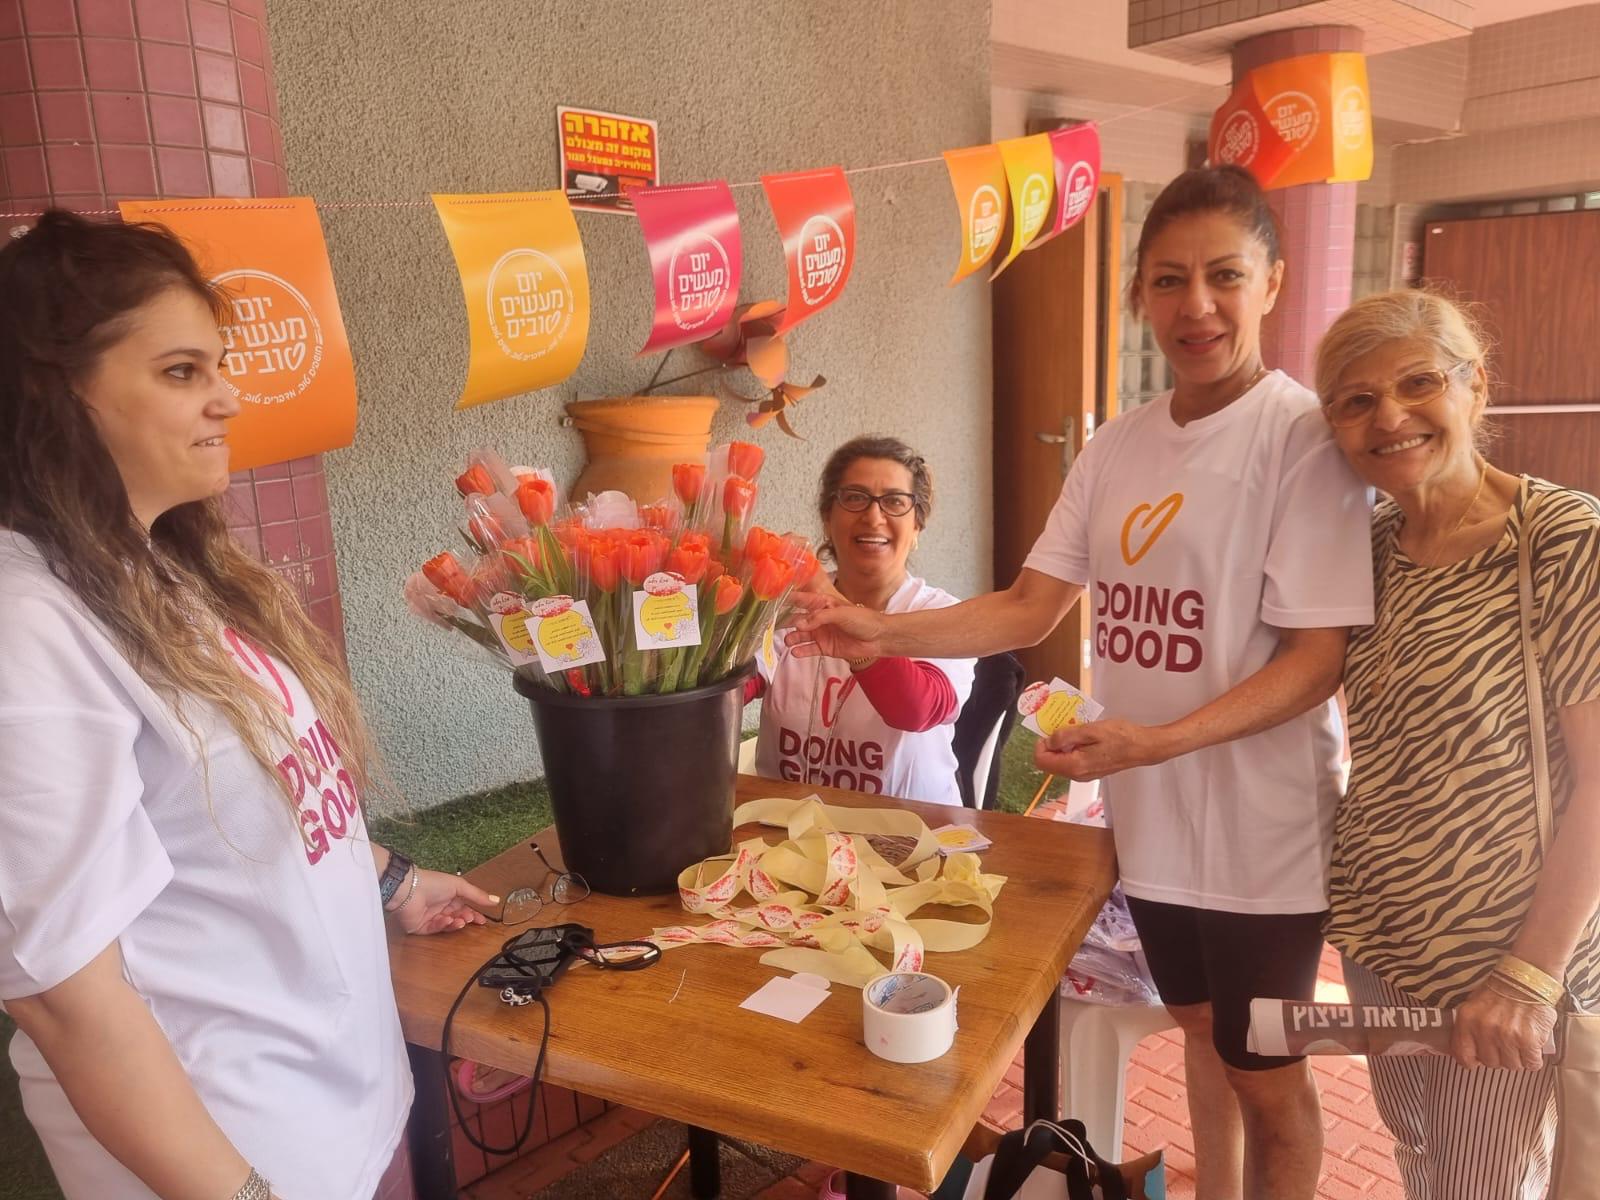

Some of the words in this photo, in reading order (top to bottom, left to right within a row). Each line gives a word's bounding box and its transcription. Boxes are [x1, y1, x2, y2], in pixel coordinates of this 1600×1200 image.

[565, 113, 649, 143] אזהרה
[566, 136, 603, 151] מצולם
[567, 152, 585, 161] סגור
[606, 143, 619, 153] זה
[622, 146, 651, 158] מקום
[814, 233, 831, 253] יום
[690, 252, 711, 273] יום
[516, 271, 543, 294] יום
[678, 268, 724, 294] מעשים
[233, 296, 273, 322] יום
[499, 288, 564, 317] מעשים
[680, 286, 721, 312] טובים
[505, 309, 562, 339] טובים
[222, 341, 307, 377] טובים
[1096, 580, 1205, 631] DOING
[1095, 621, 1204, 674] GOOD
[779, 726, 884, 771] DOING
[276, 717, 341, 808] DOIN
[779, 759, 884, 796] GOOD
[1292, 1005, 1355, 1032] פיצוץ
